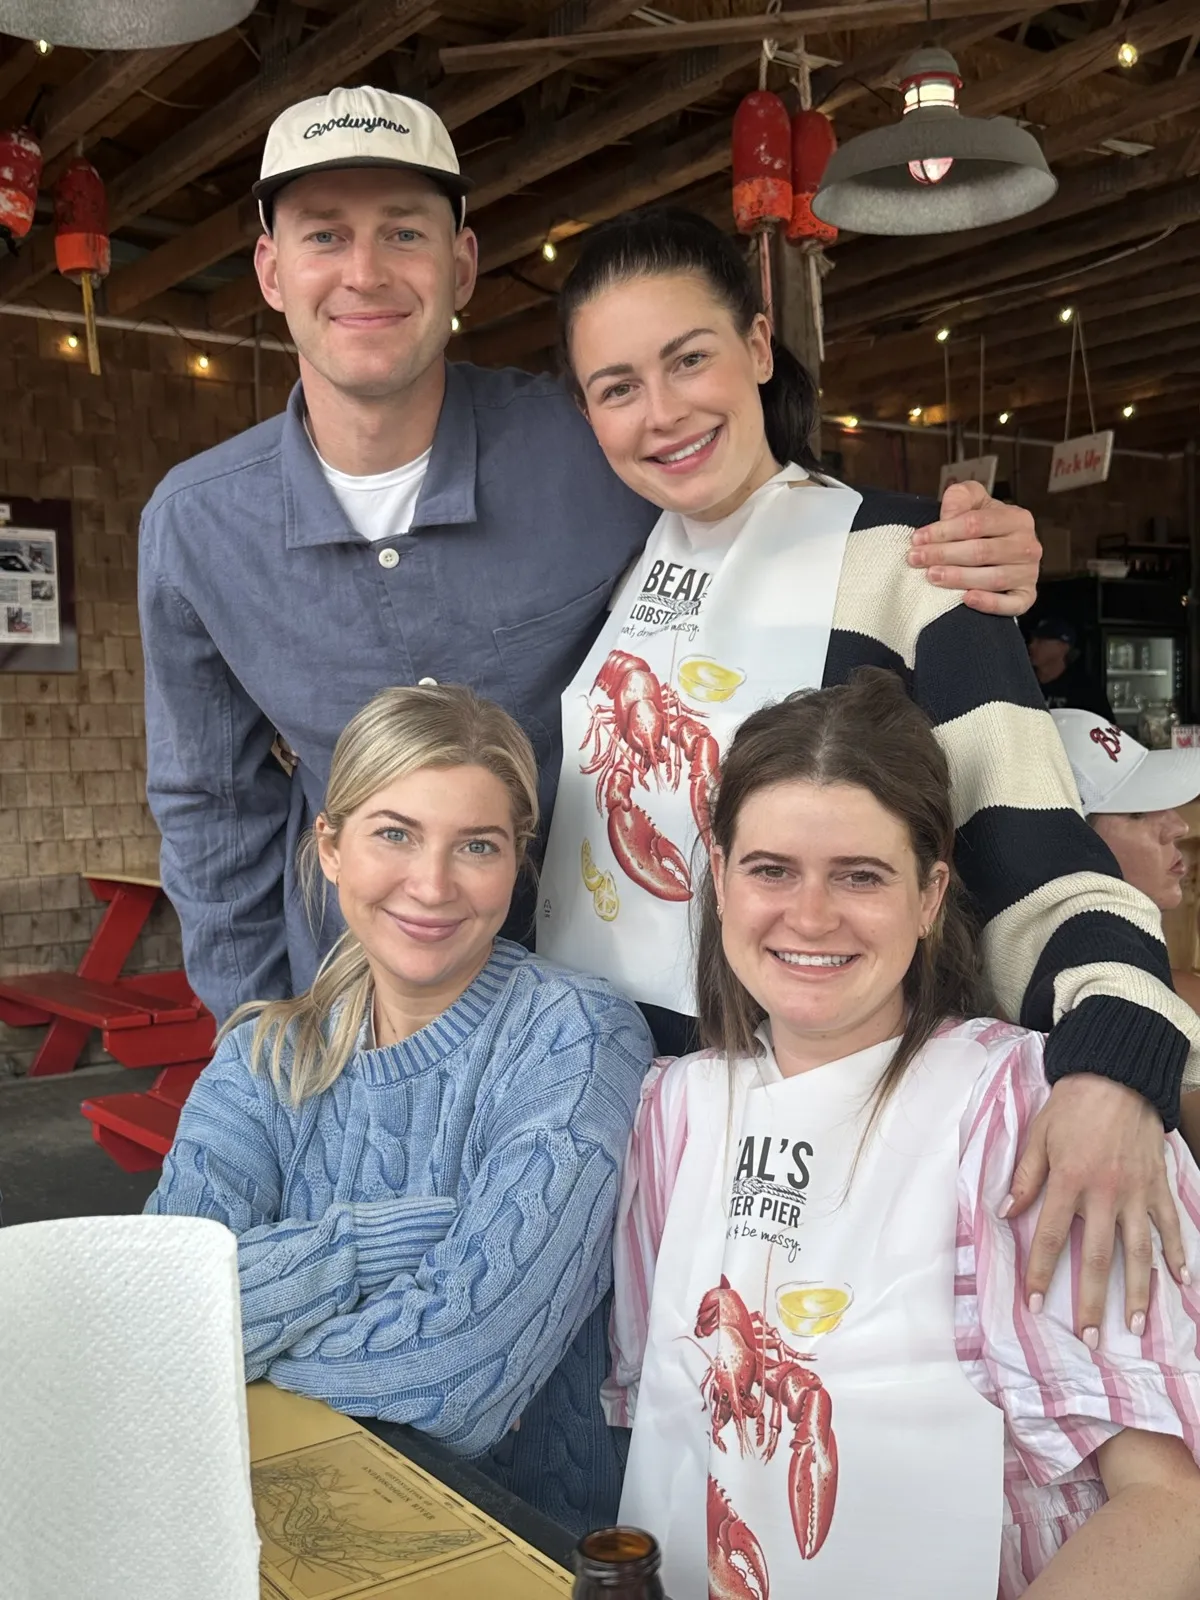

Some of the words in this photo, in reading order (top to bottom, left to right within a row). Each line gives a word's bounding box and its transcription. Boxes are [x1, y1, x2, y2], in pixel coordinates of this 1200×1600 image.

[1084, 448, 1103, 471] Up
[759, 1197, 801, 1228] PIER
[741, 1220, 757, 1238] be
[760, 1231, 802, 1264] messy.
[411, 1502, 436, 1520] RIVER
